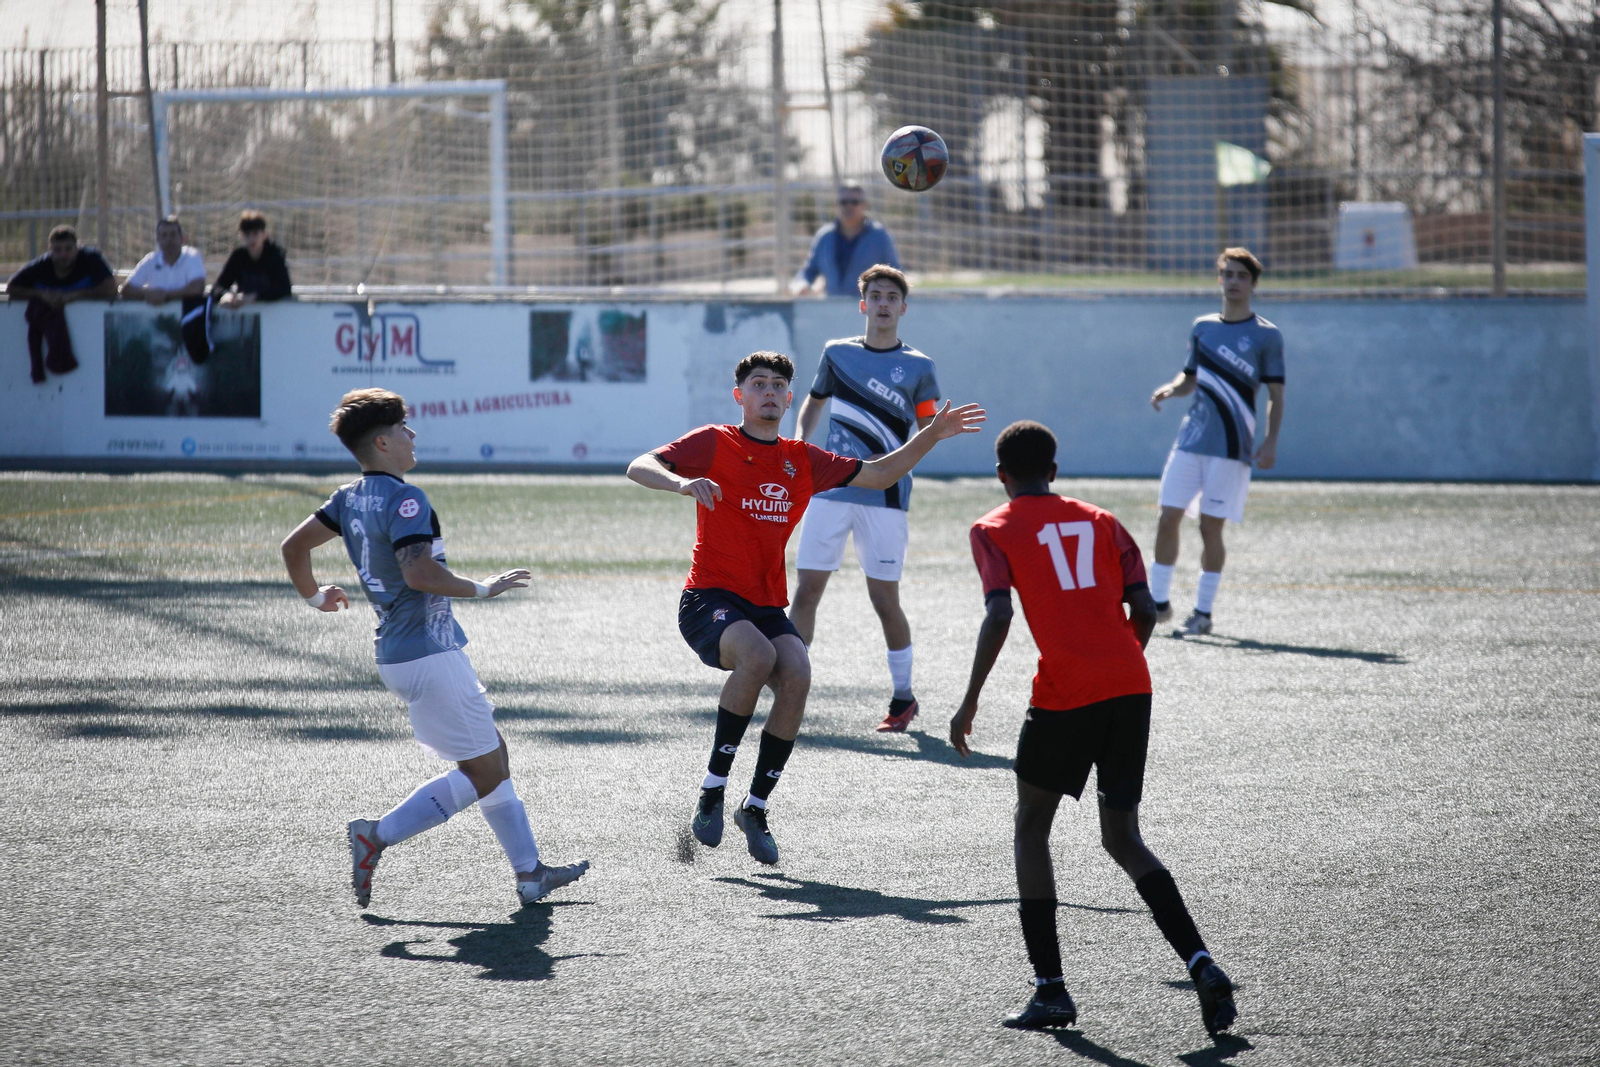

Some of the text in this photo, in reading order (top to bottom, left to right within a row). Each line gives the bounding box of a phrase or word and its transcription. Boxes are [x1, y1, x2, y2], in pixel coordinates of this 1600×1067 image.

[420, 401, 447, 418] POR
[452, 400, 468, 415] LA
[473, 390, 572, 414] AGRICULTURA
[741, 498, 794, 513] HYUND
[1036, 520, 1097, 591] 17
